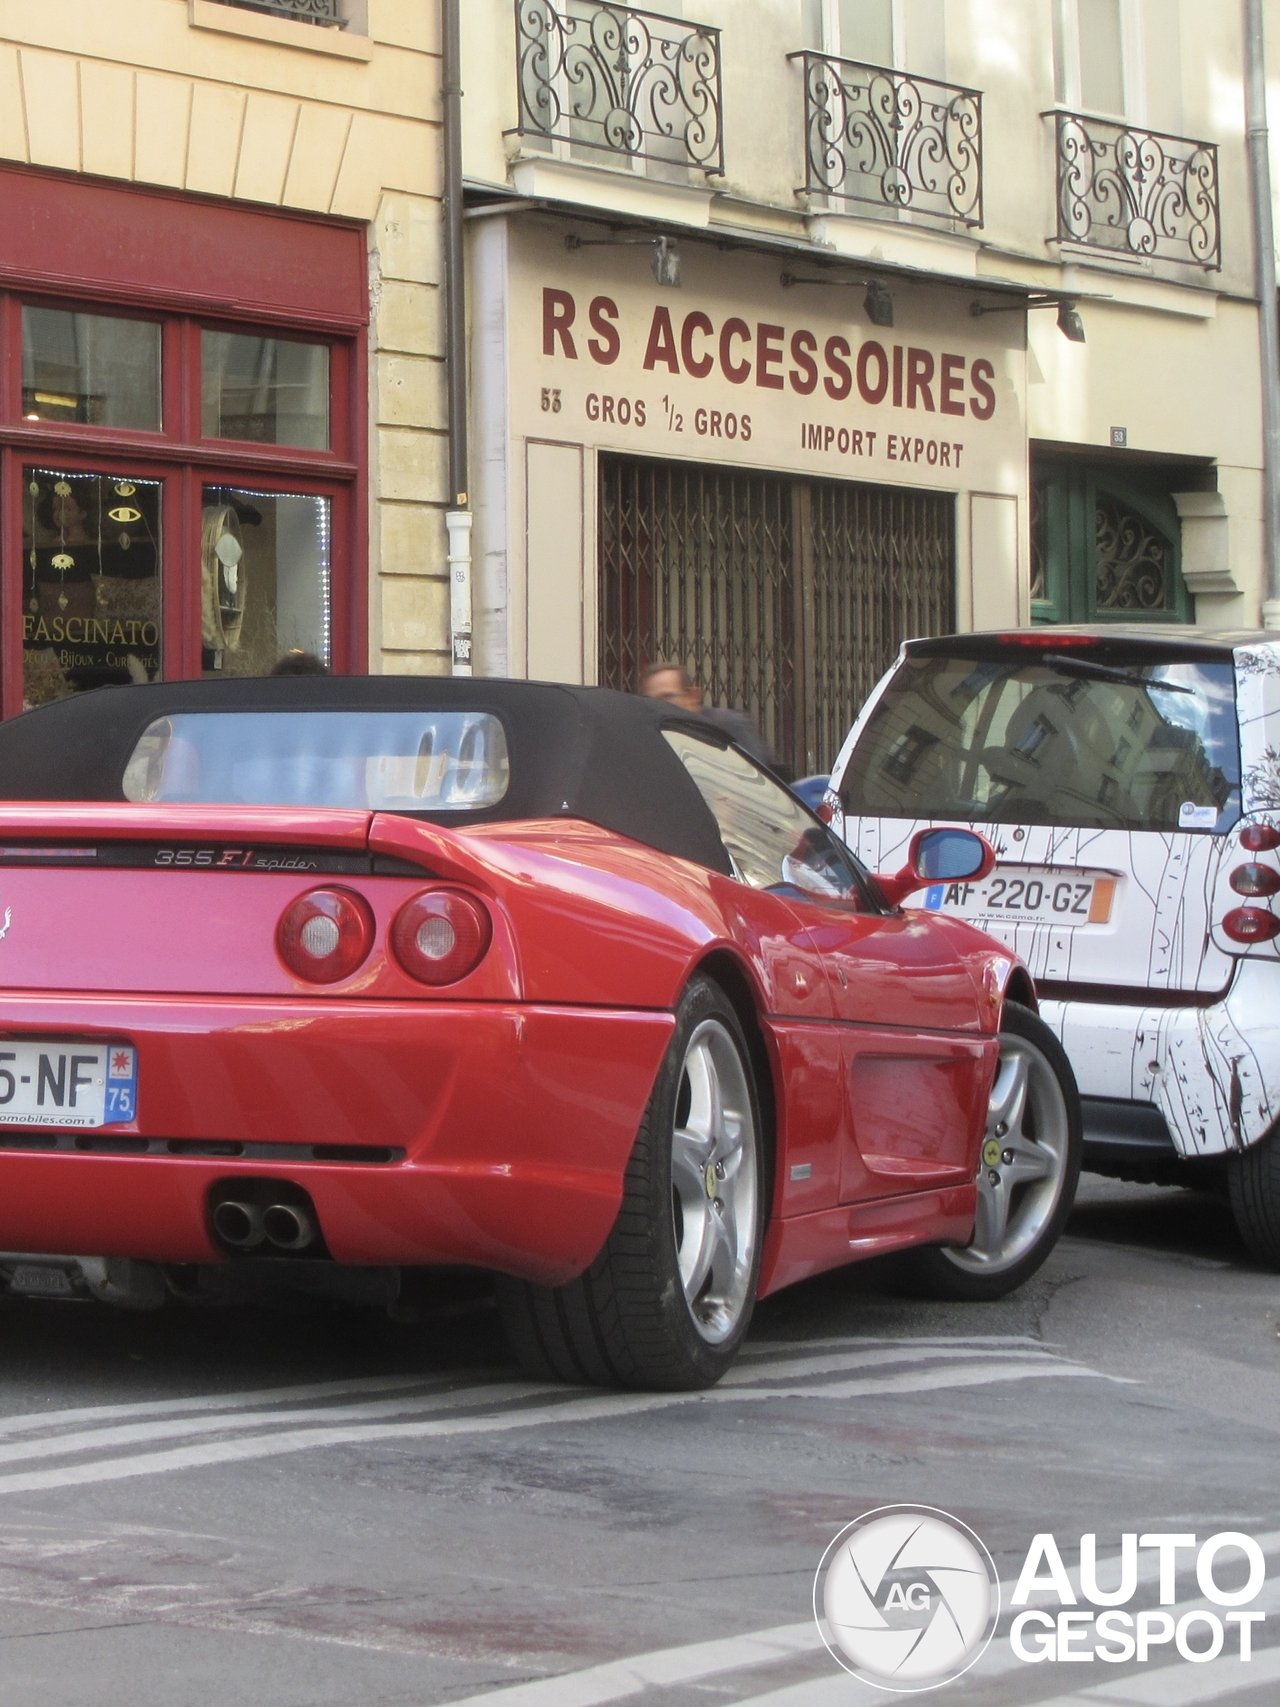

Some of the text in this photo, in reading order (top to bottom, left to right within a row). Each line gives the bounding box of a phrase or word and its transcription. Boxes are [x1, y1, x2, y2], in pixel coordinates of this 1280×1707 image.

[542, 287, 996, 421] RS ACCESSOIRES
[541, 387, 562, 413] 53
[585, 393, 647, 427] GROS
[694, 408, 752, 441] GROS
[801, 423, 964, 469] IMPORT EXPORT
[22, 615, 159, 646] FASCINATO
[154, 850, 318, 870] 355 F1 spider
[108, 1087, 130, 1112] 75
